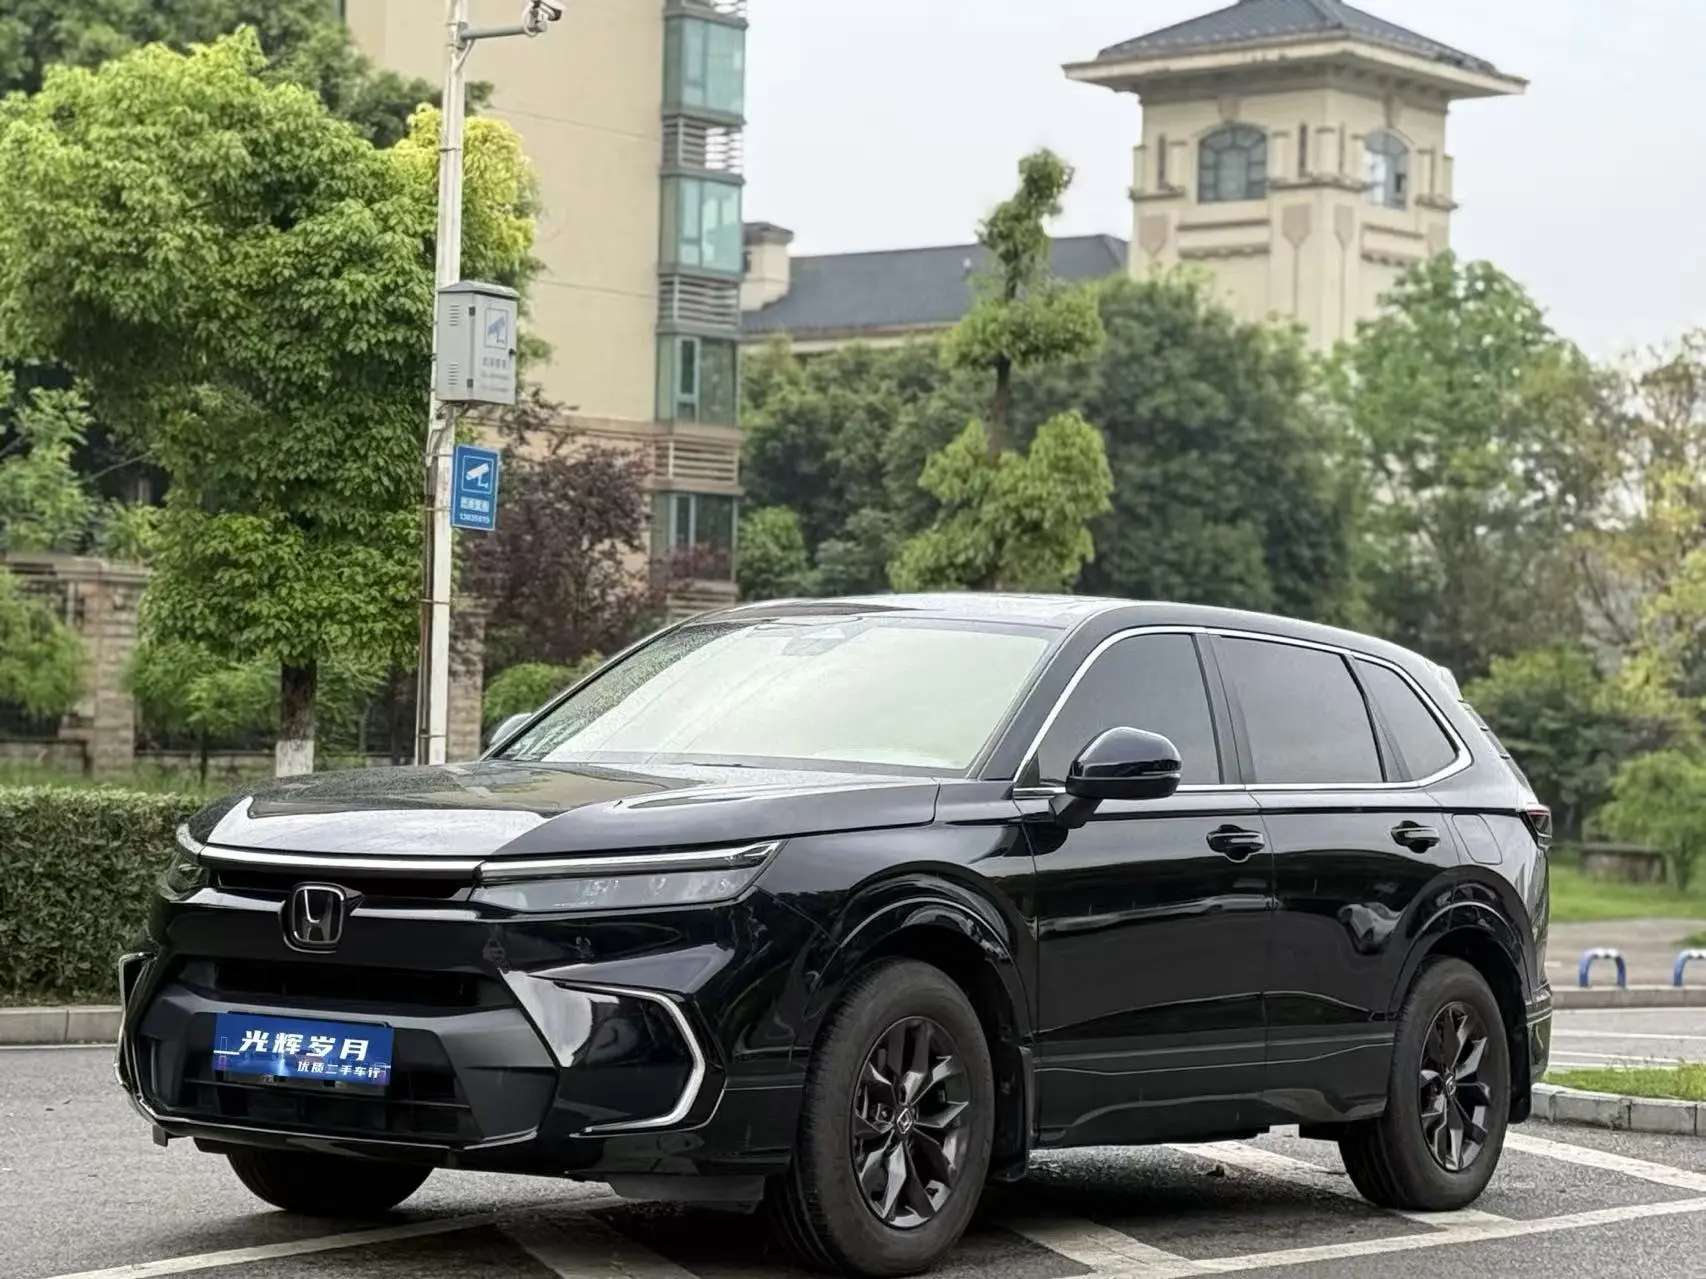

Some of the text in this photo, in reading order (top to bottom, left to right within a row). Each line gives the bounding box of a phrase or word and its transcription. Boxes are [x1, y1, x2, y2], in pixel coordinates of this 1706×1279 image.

[239, 1030, 369, 1061] 光辉岁月
[297, 1060, 381, 1079] 优质二手车行
